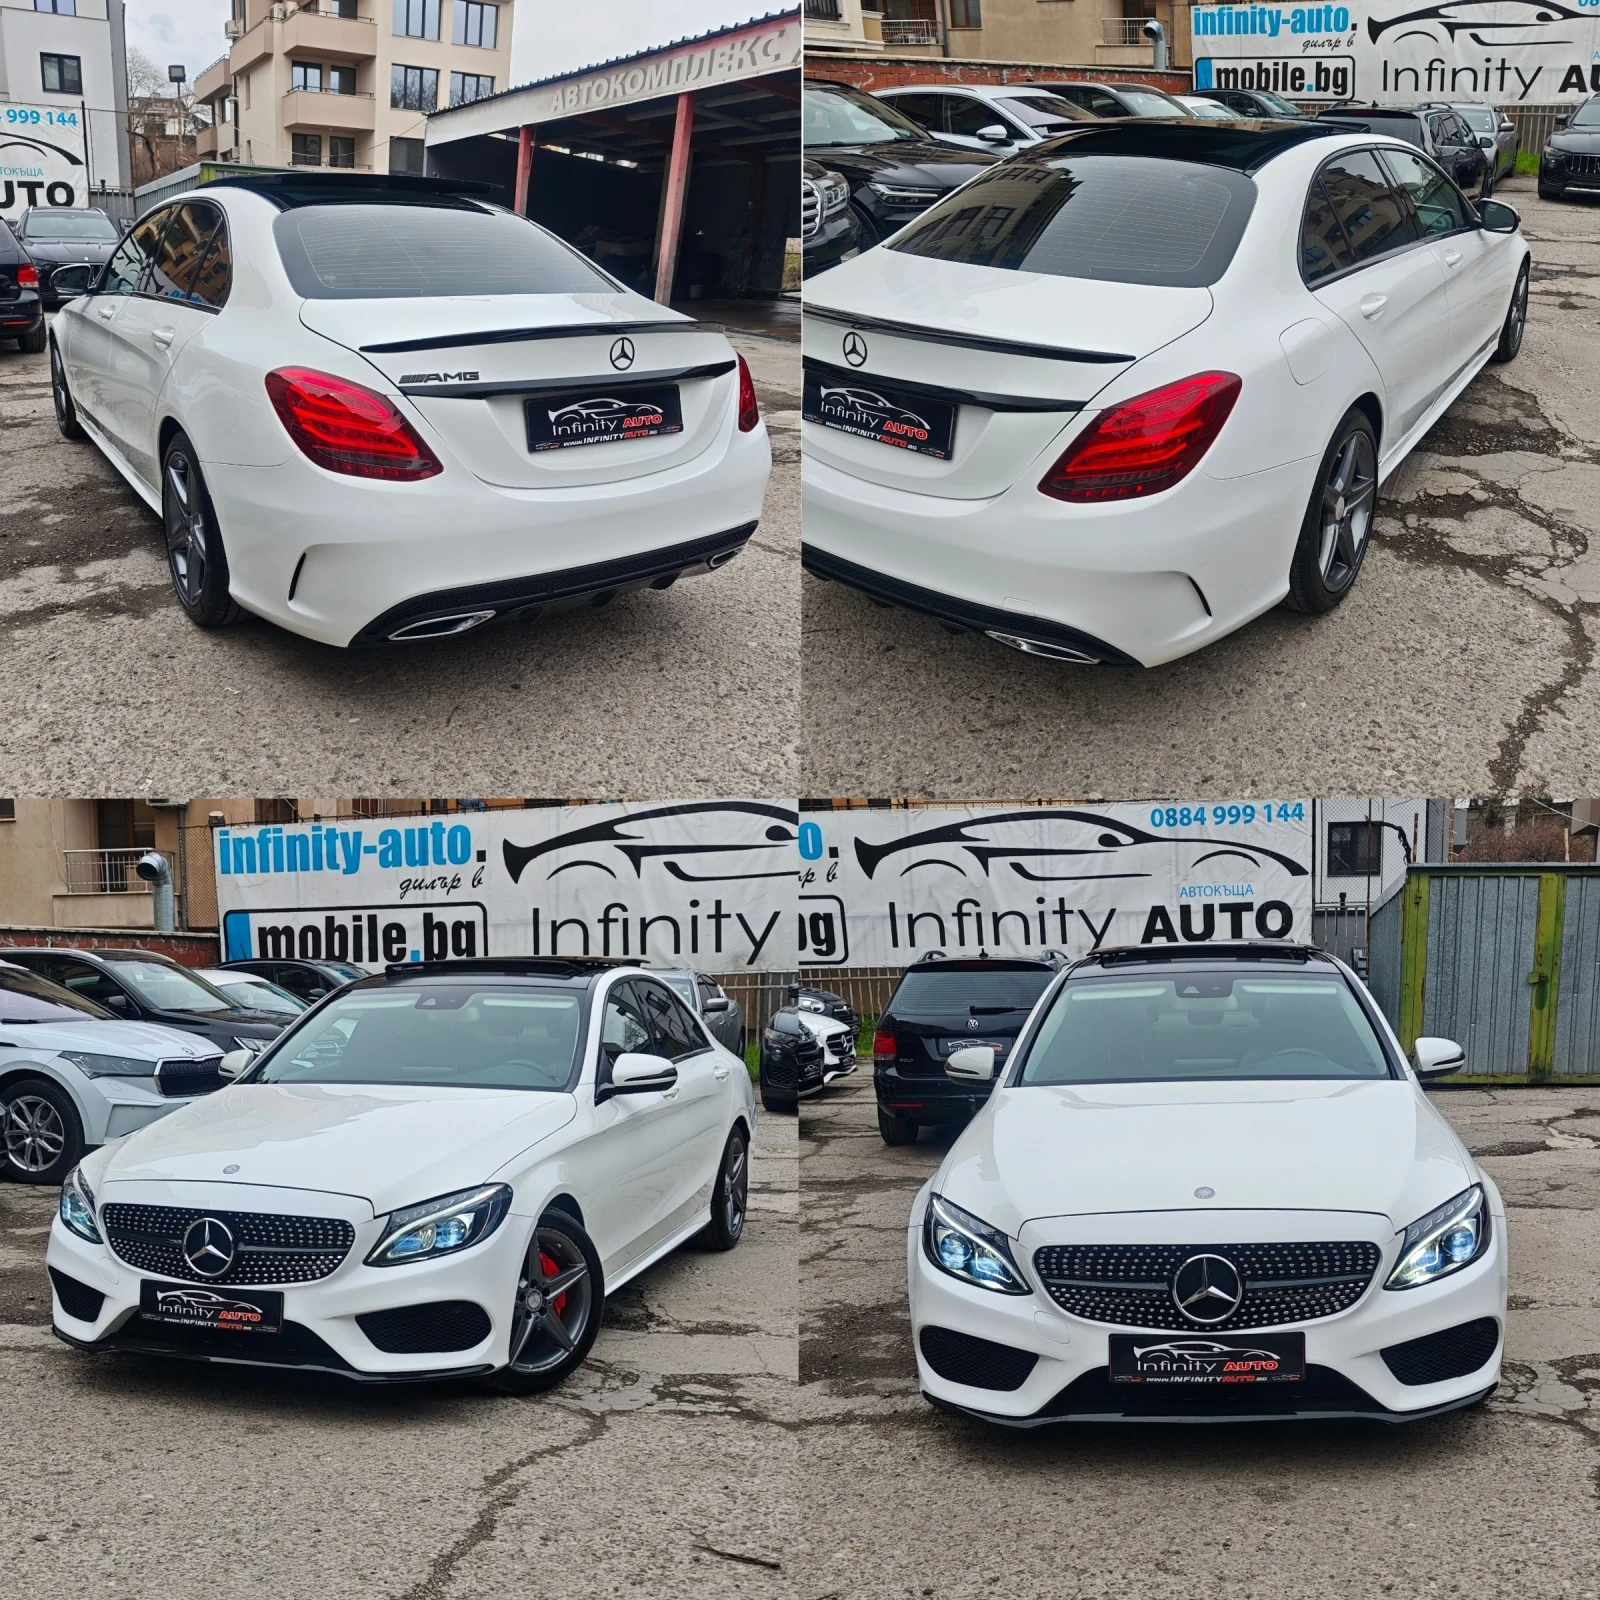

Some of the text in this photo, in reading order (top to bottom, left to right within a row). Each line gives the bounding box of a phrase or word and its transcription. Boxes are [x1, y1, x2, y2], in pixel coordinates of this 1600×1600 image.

[550, 29, 786, 112] АВТОКОМПЛЕКС
[1216, 61, 1348, 96] mobile.bg
[1383, 57, 1543, 100] Infinity
[6, 109, 78, 126] 999 144
[552, 414, 663, 436] Infinity AUTO
[820, 401, 928, 440] Infinity AUTO
[1150, 803, 1305, 828] 0884 999 144
[1180, 884, 1254, 899] АВТОКЪЩА
[532, 899, 781, 965] Infinity
[888, 898, 1294, 950] Infinity AUTO
[158, 1302, 214, 1318] Infinity
[219, 1311, 262, 1321] AUTO
[1137, 1360, 1278, 1373] Infinity AUTO
